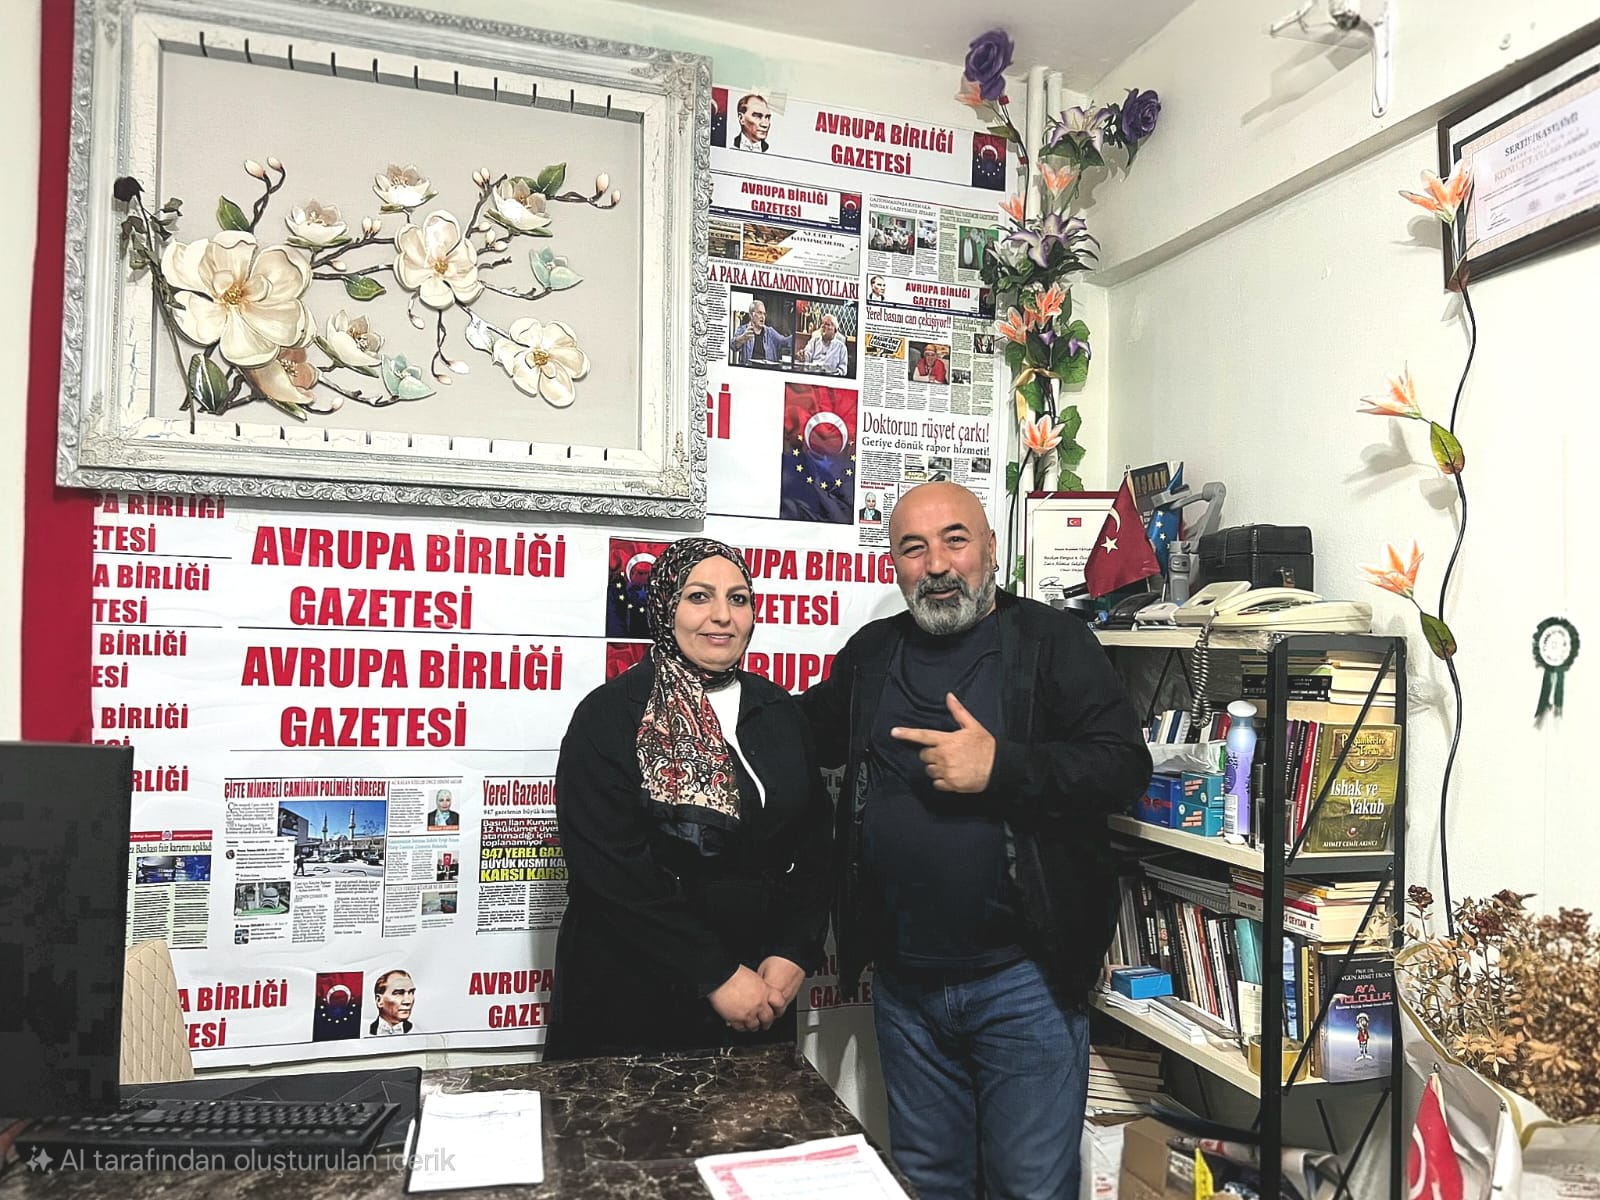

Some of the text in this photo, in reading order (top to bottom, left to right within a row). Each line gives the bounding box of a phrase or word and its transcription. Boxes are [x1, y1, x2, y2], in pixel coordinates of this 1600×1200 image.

[815, 111, 954, 154] AVRUPA BİRLİĞİ
[831, 144, 912, 175] GAZETESİ
[741, 182, 785, 199] AVRUPA
[751, 200, 802, 217] GAZETESİ
[720, 266, 747, 286] PARA
[751, 270, 815, 293] AKLAMININ
[815, 279, 859, 299] YOLLARI
[905, 282, 939, 295] AVRUPA
[866, 307, 882, 321] Yerel
[913, 296, 951, 309] GAZETESİ
[863, 412, 989, 446] Doktorun rüşvet çarkı!
[862, 437, 892, 449] Geriye
[895, 439, 923, 451] dönük
[926, 442, 950, 454] rapor
[250, 525, 567, 579] AVRUPA BİRLİĞİ
[117, 561, 210, 591] BİRLİĞİ
[289, 585, 473, 630] GAZETESİ
[99, 630, 187, 657] BİRLİĞİ
[240, 643, 564, 691] AVRUPA BİRLİĞİ
[101, 703, 188, 729] BİRLİĞİ
[280, 701, 467, 748] GAZETESİ
[224, 778, 245, 801] ÇİFTE
[247, 778, 282, 799] MİNARELİ
[483, 780, 511, 806] Yerel
[1366, 783, 1378, 797] ve
[1349, 798, 1386, 815] Yakub
[482, 848, 503, 859] 947
[505, 847, 537, 858] YEREL
[469, 969, 554, 995] AVRUPA
[197, 979, 288, 1012] BİRLİĞİ
